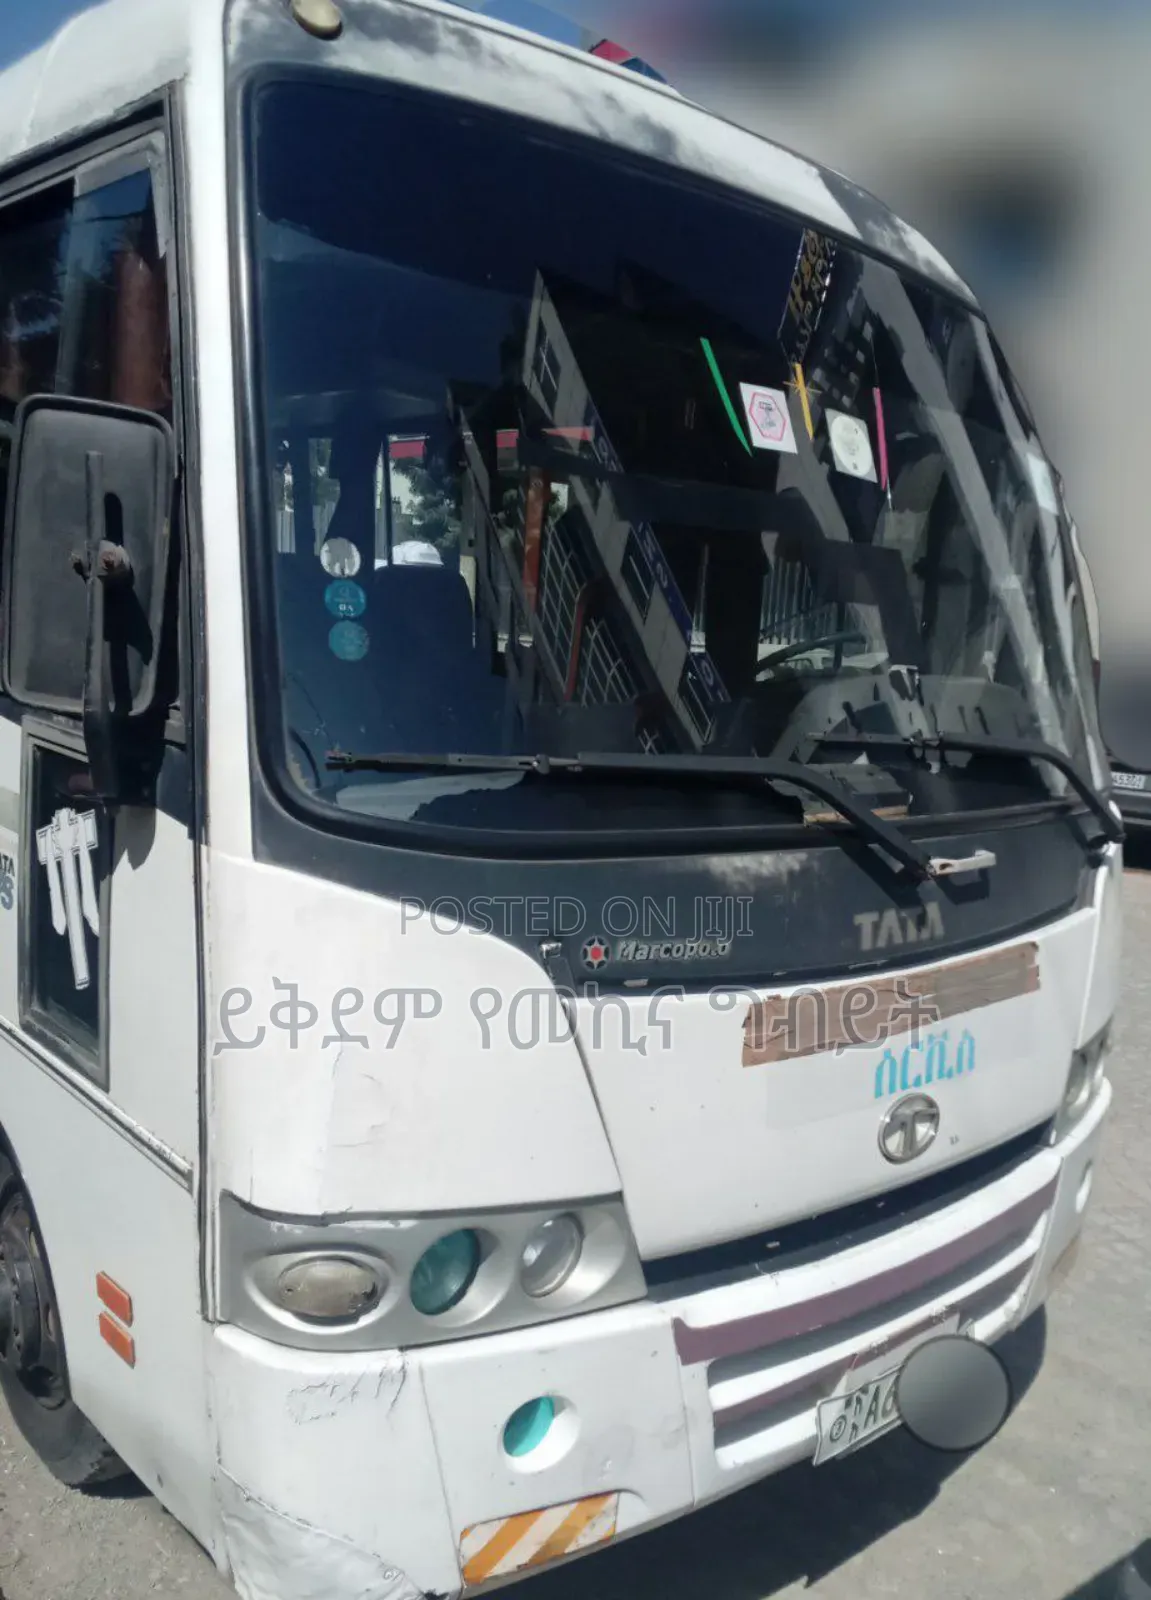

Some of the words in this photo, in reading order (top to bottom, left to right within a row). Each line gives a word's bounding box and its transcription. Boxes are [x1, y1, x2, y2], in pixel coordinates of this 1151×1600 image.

[0, 852, 15, 877] TA
[853, 902, 946, 951] TATA
[617, 939, 732, 961] Marcopoo
